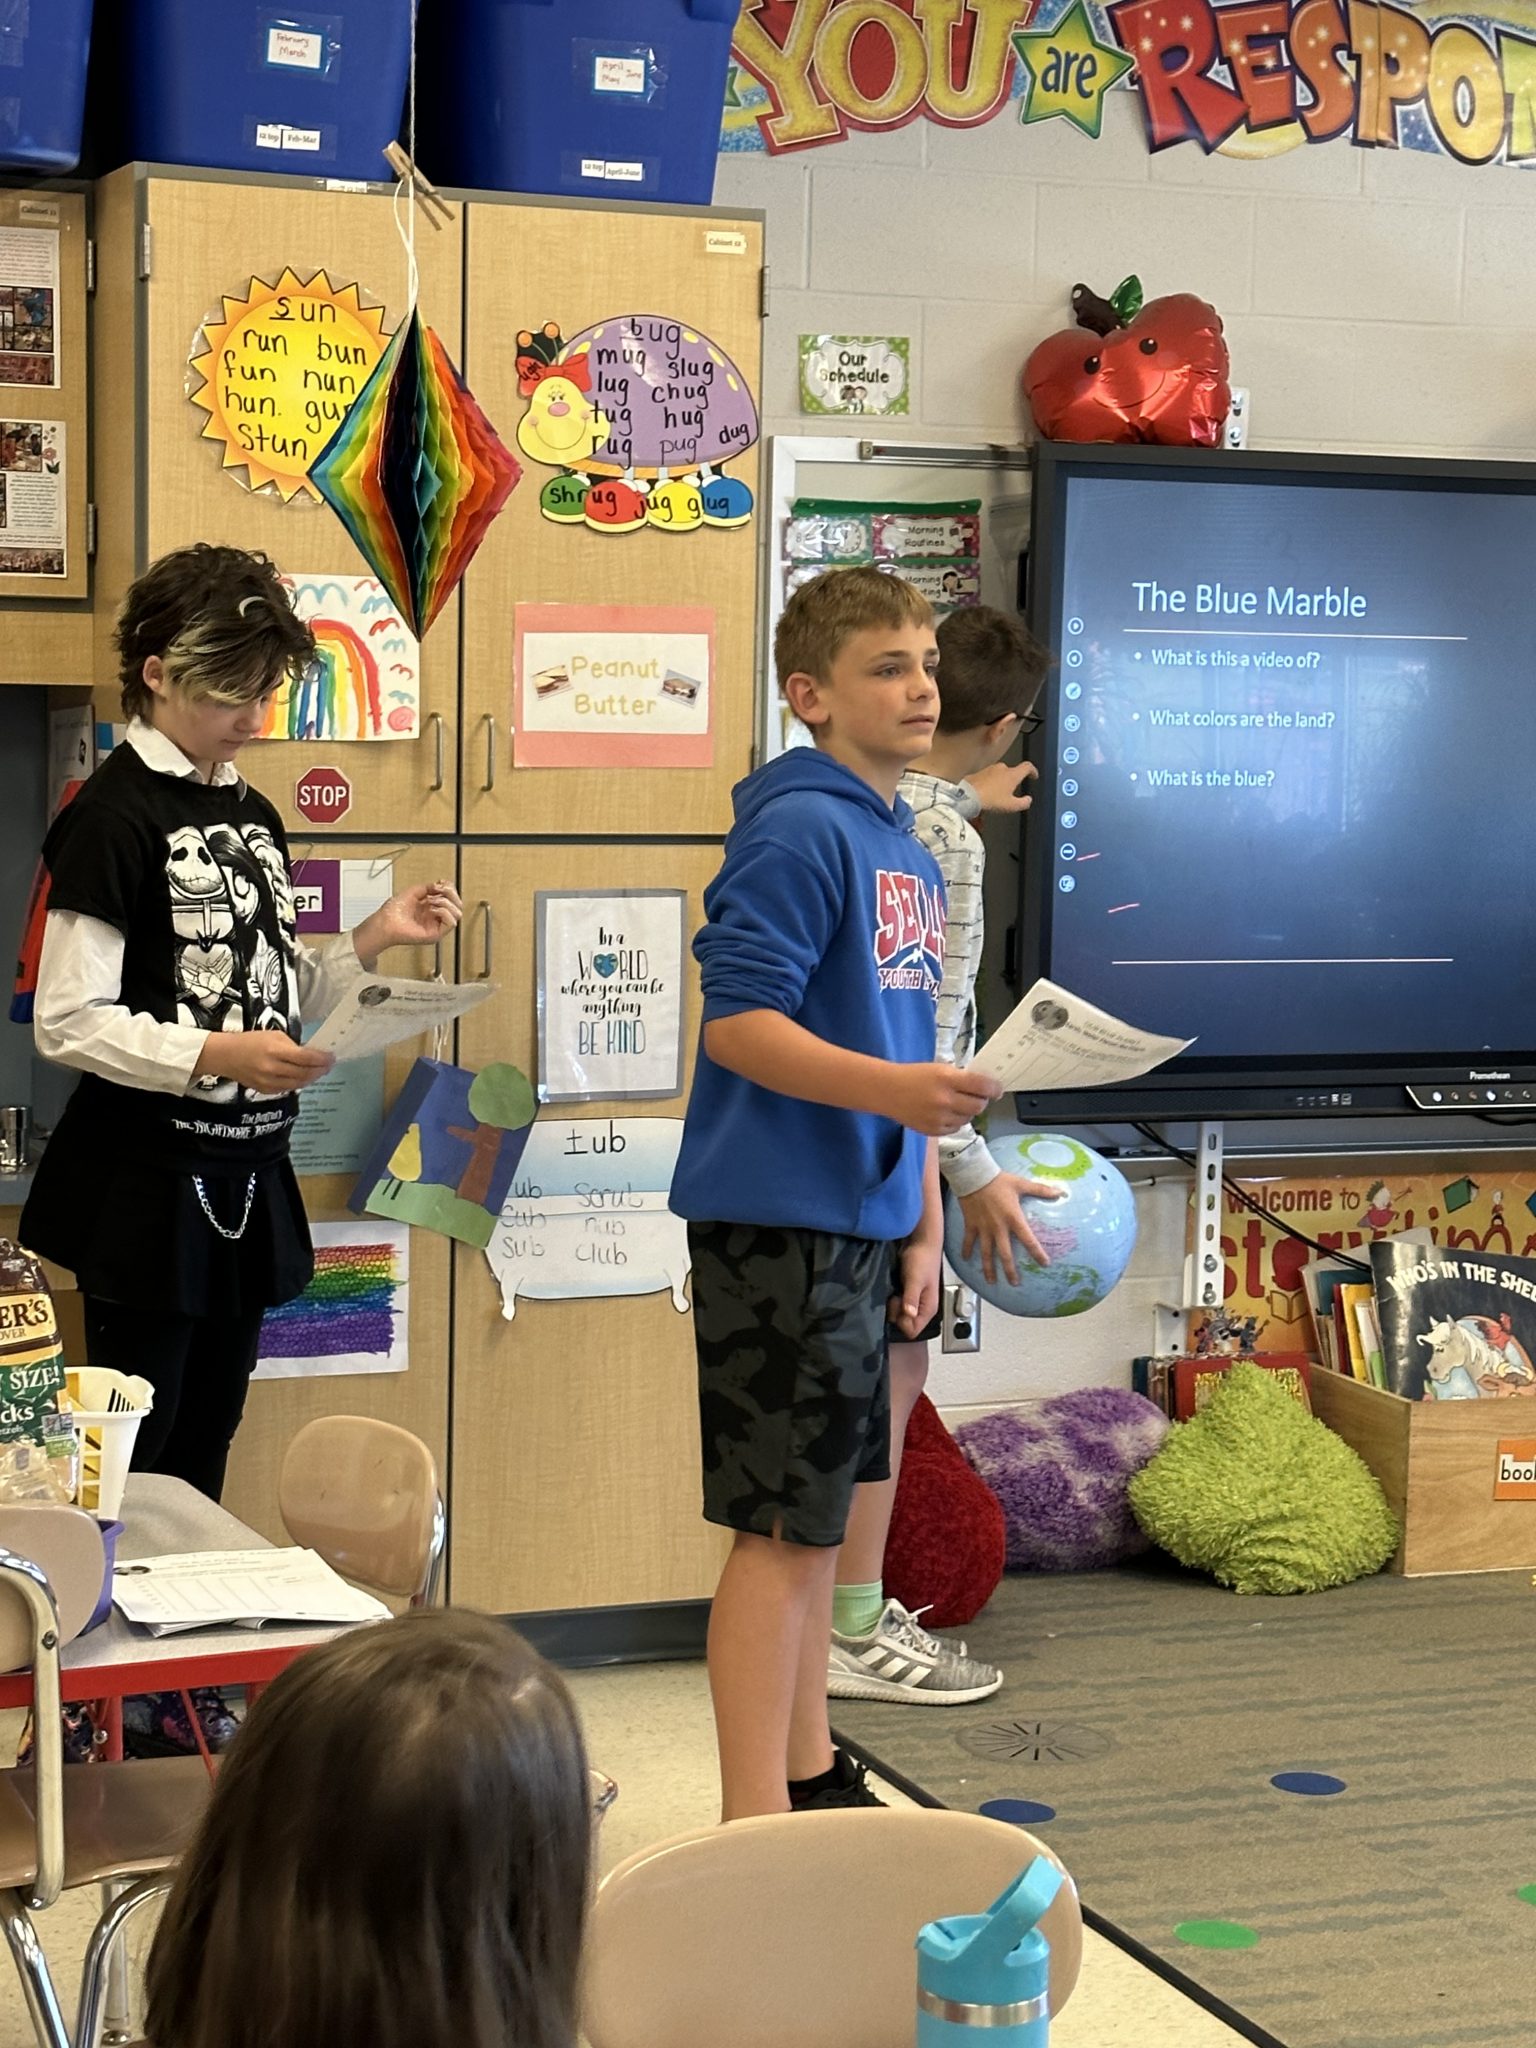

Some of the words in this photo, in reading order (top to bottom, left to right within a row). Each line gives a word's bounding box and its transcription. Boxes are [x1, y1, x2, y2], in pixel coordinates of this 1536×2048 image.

[276, 32, 309, 48] February
[732, 0, 1035, 148] YOU
[1041, 45, 1098, 98] are
[243, 329, 288, 356] run
[317, 334, 367, 366] bun
[619, 318, 681, 360] bug
[596, 348, 646, 377] mug
[838, 351, 868, 366] Our
[223, 350, 277, 382] fun
[303, 369, 356, 395] nun
[667, 358, 714, 386] slug
[819, 367, 890, 384] Schedule
[597, 371, 629, 406] lug
[651, 382, 709, 410] chug
[589, 401, 632, 436] tug
[663, 407, 705, 439] hug
[718, 423, 750, 446] dug
[591, 434, 633, 470] rug
[659, 437, 697, 465] pug
[550, 485, 618, 517] shrug
[634, 492, 671, 523] jug
[687, 493, 730, 520] glug
[904, 537, 946, 547] Routines
[907, 525, 944, 536] Morning
[1132, 581, 1187, 613] The
[1196, 582, 1258, 614] Blue
[1266, 586, 1367, 618] Marble
[571, 655, 661, 679] Peanut
[1151, 649, 1193, 666] What
[1196, 650, 1208, 666] is
[1210, 650, 1238, 667] this
[1239, 654, 1250, 667] a
[1253, 651, 1294, 668] video
[1296, 652, 1321, 669] of?
[574, 694, 657, 716] Butter
[1149, 709, 1191, 726] What
[1193, 710, 1237, 727] colors
[1240, 714, 1265, 727] are
[1267, 711, 1292, 727] the
[1295, 711, 1336, 728] land?
[1147, 769, 1189, 786] What
[1191, 770, 1203, 787] is
[1206, 770, 1231, 787] the
[1234, 770, 1276, 788] blue?
[300, 785, 347, 807] STOP
[293, 895, 320, 911] er
[616, 933, 625, 945] a
[561, 978, 599, 997] where
[878, 967, 923, 991] YOUTH
[582, 998, 642, 1021] anything
[578, 1020, 601, 1056] BE
[606, 1019, 646, 1056] KIND
[514, 1176, 543, 1199] ub
[1229, 1184, 1332, 1215] welcome
[1340, 1188, 1360, 1210] to
[1386, 1260, 1438, 1292] WHO'S
[1439, 1260, 1460, 1279] IN
[1461, 1262, 1497, 1285] THE
[10, 1364, 60, 1391] SIZE!
